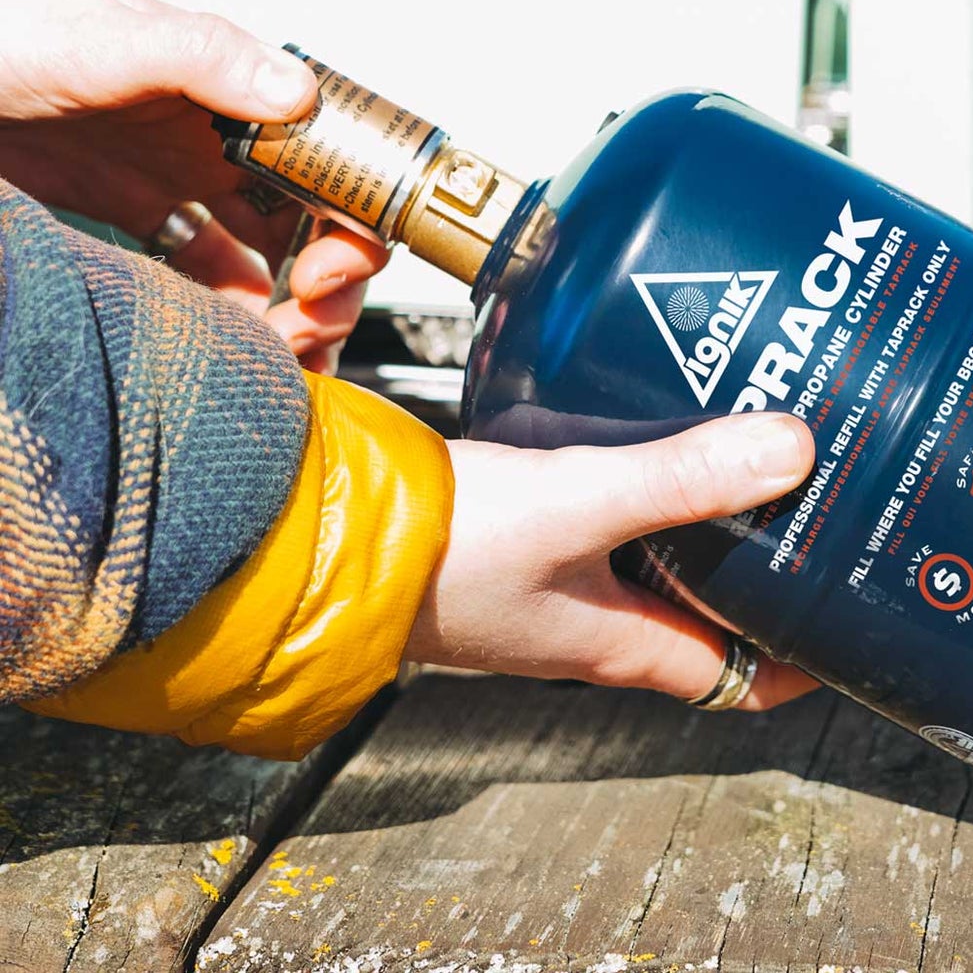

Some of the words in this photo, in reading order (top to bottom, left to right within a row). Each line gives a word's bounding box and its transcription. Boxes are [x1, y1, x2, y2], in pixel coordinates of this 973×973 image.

[291, 137, 305, 156] not
[304, 155, 316, 169] an
[327, 160, 352, 196] EVERY
[343, 173, 365, 205] Check
[359, 189, 376, 213] stem
[371, 178, 382, 189] is
[729, 199, 883, 414] PRACK
[792, 324, 853, 420] PROPANE
[842, 223, 908, 325] CYLINDER
[830, 300, 886, 395] RECHARGEABLE
[883, 240, 919, 297] TAPRACK
[769, 456, 838, 572] PROFESSIONAL
[829, 401, 867, 456] REFILL
[859, 359, 889, 402] WITH
[881, 284, 929, 360] TAPRACK
[920, 239, 953, 285] ONLY
[789, 514, 826, 573] RECHARGE
[821, 409, 881, 512] PROFESSIONNELLE
[876, 377, 897, 408] AVEC
[893, 323, 926, 376] TAPRACK
[921, 255, 962, 322] SEULEMENT
[847, 553, 874, 589] FILL
[865, 495, 904, 554] WHERE
[895, 460, 923, 497] YOU
[914, 425, 941, 461] FILL
[932, 380, 965, 426] YOUR
[887, 530, 905, 555] FILL
[901, 506, 918, 528] QUI
[913, 474, 934, 505] VOUS
[944, 409, 968, 446] VOTRE
[906, 544, 932, 586] SAVE
